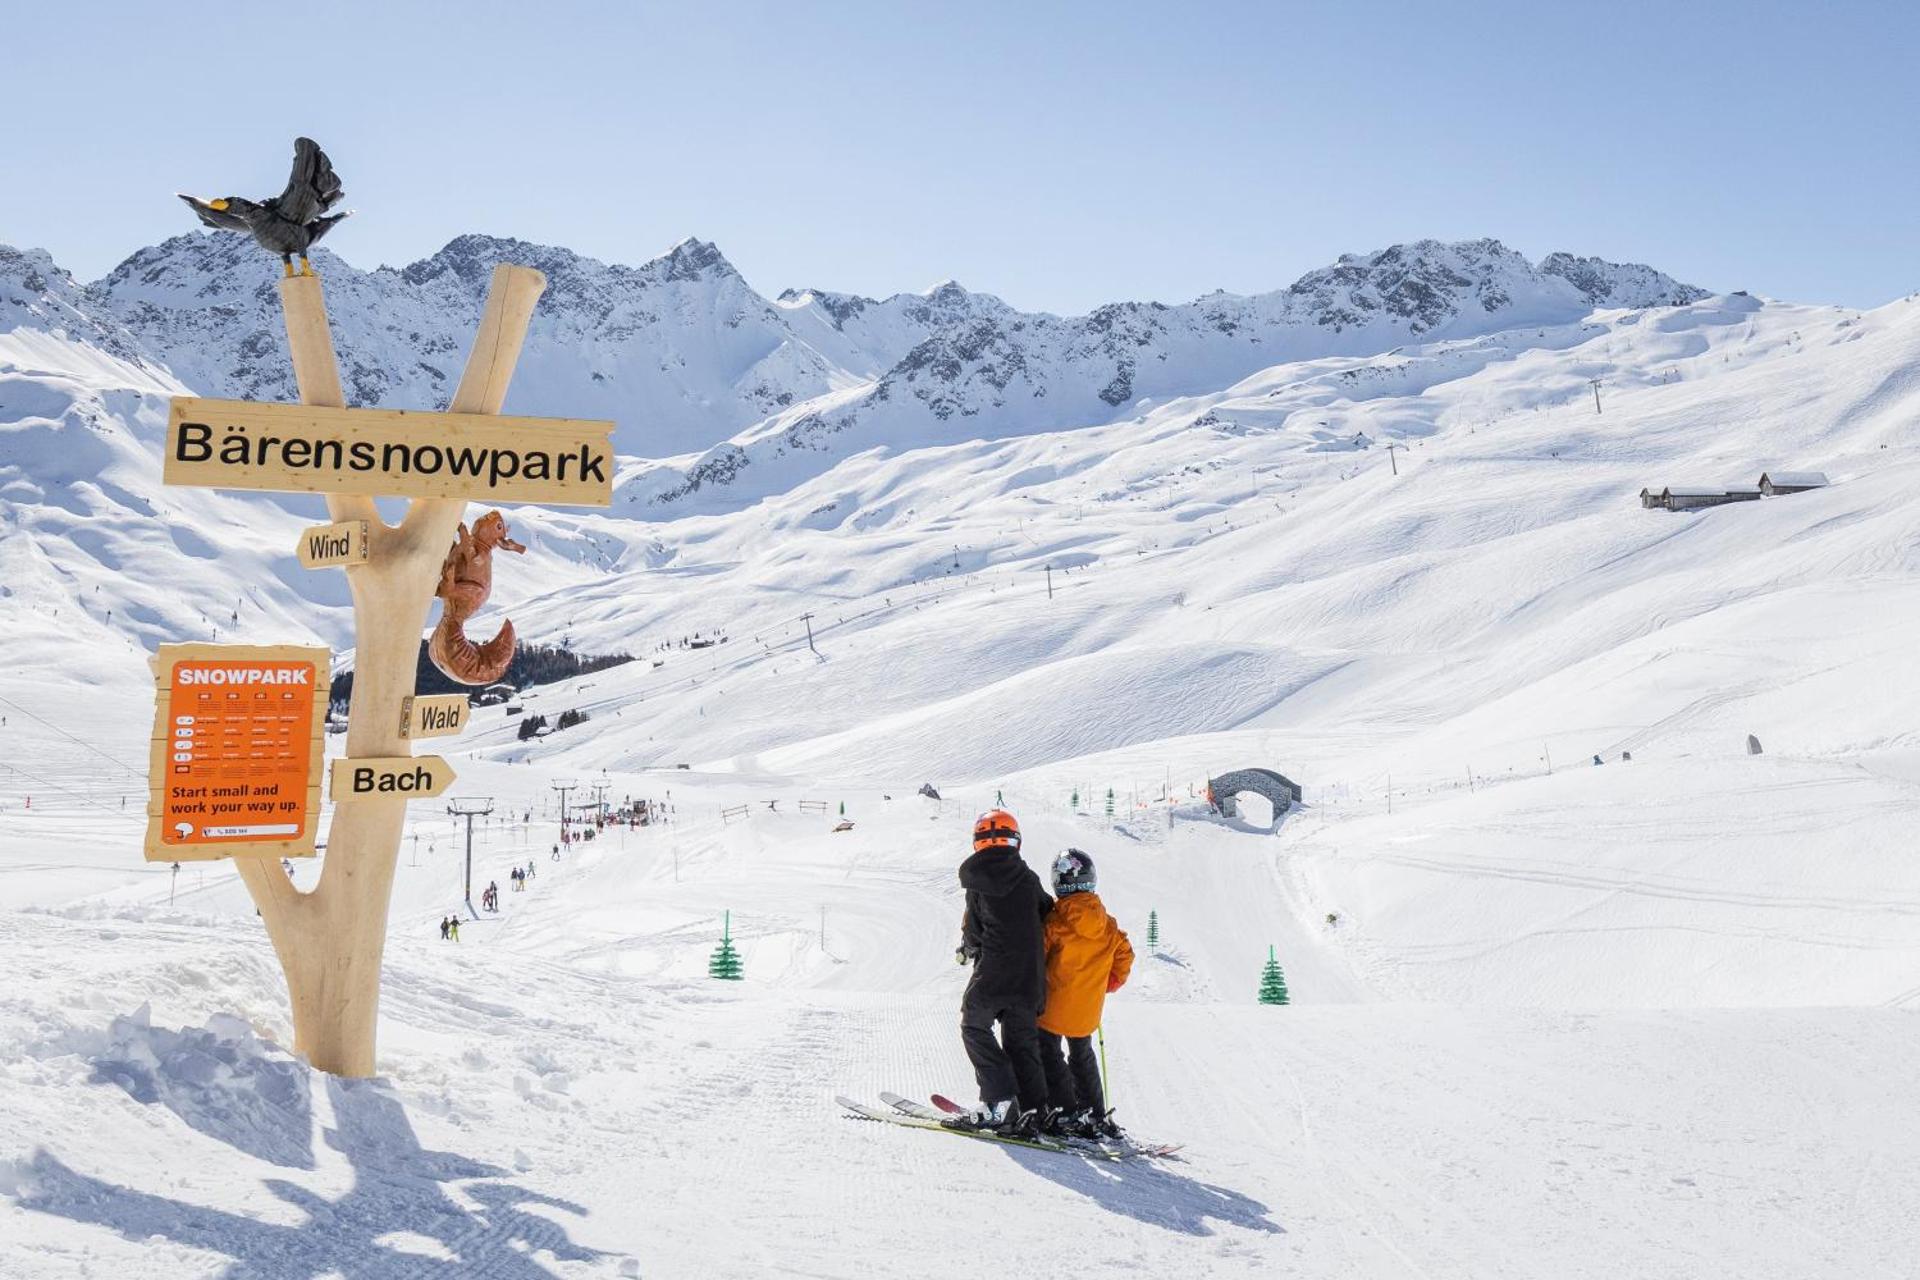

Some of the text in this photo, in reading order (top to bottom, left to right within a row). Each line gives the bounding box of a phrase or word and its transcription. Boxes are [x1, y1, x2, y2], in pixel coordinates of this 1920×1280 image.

[176, 421, 606, 487] Bärensnowpark
[309, 531, 350, 561] Wind
[178, 668, 308, 685] SNOWPARK
[422, 704, 460, 731] Wald
[172, 784, 278, 798] Start small and
[353, 766, 432, 793] Bach
[171, 801, 300, 815] work your way up.
